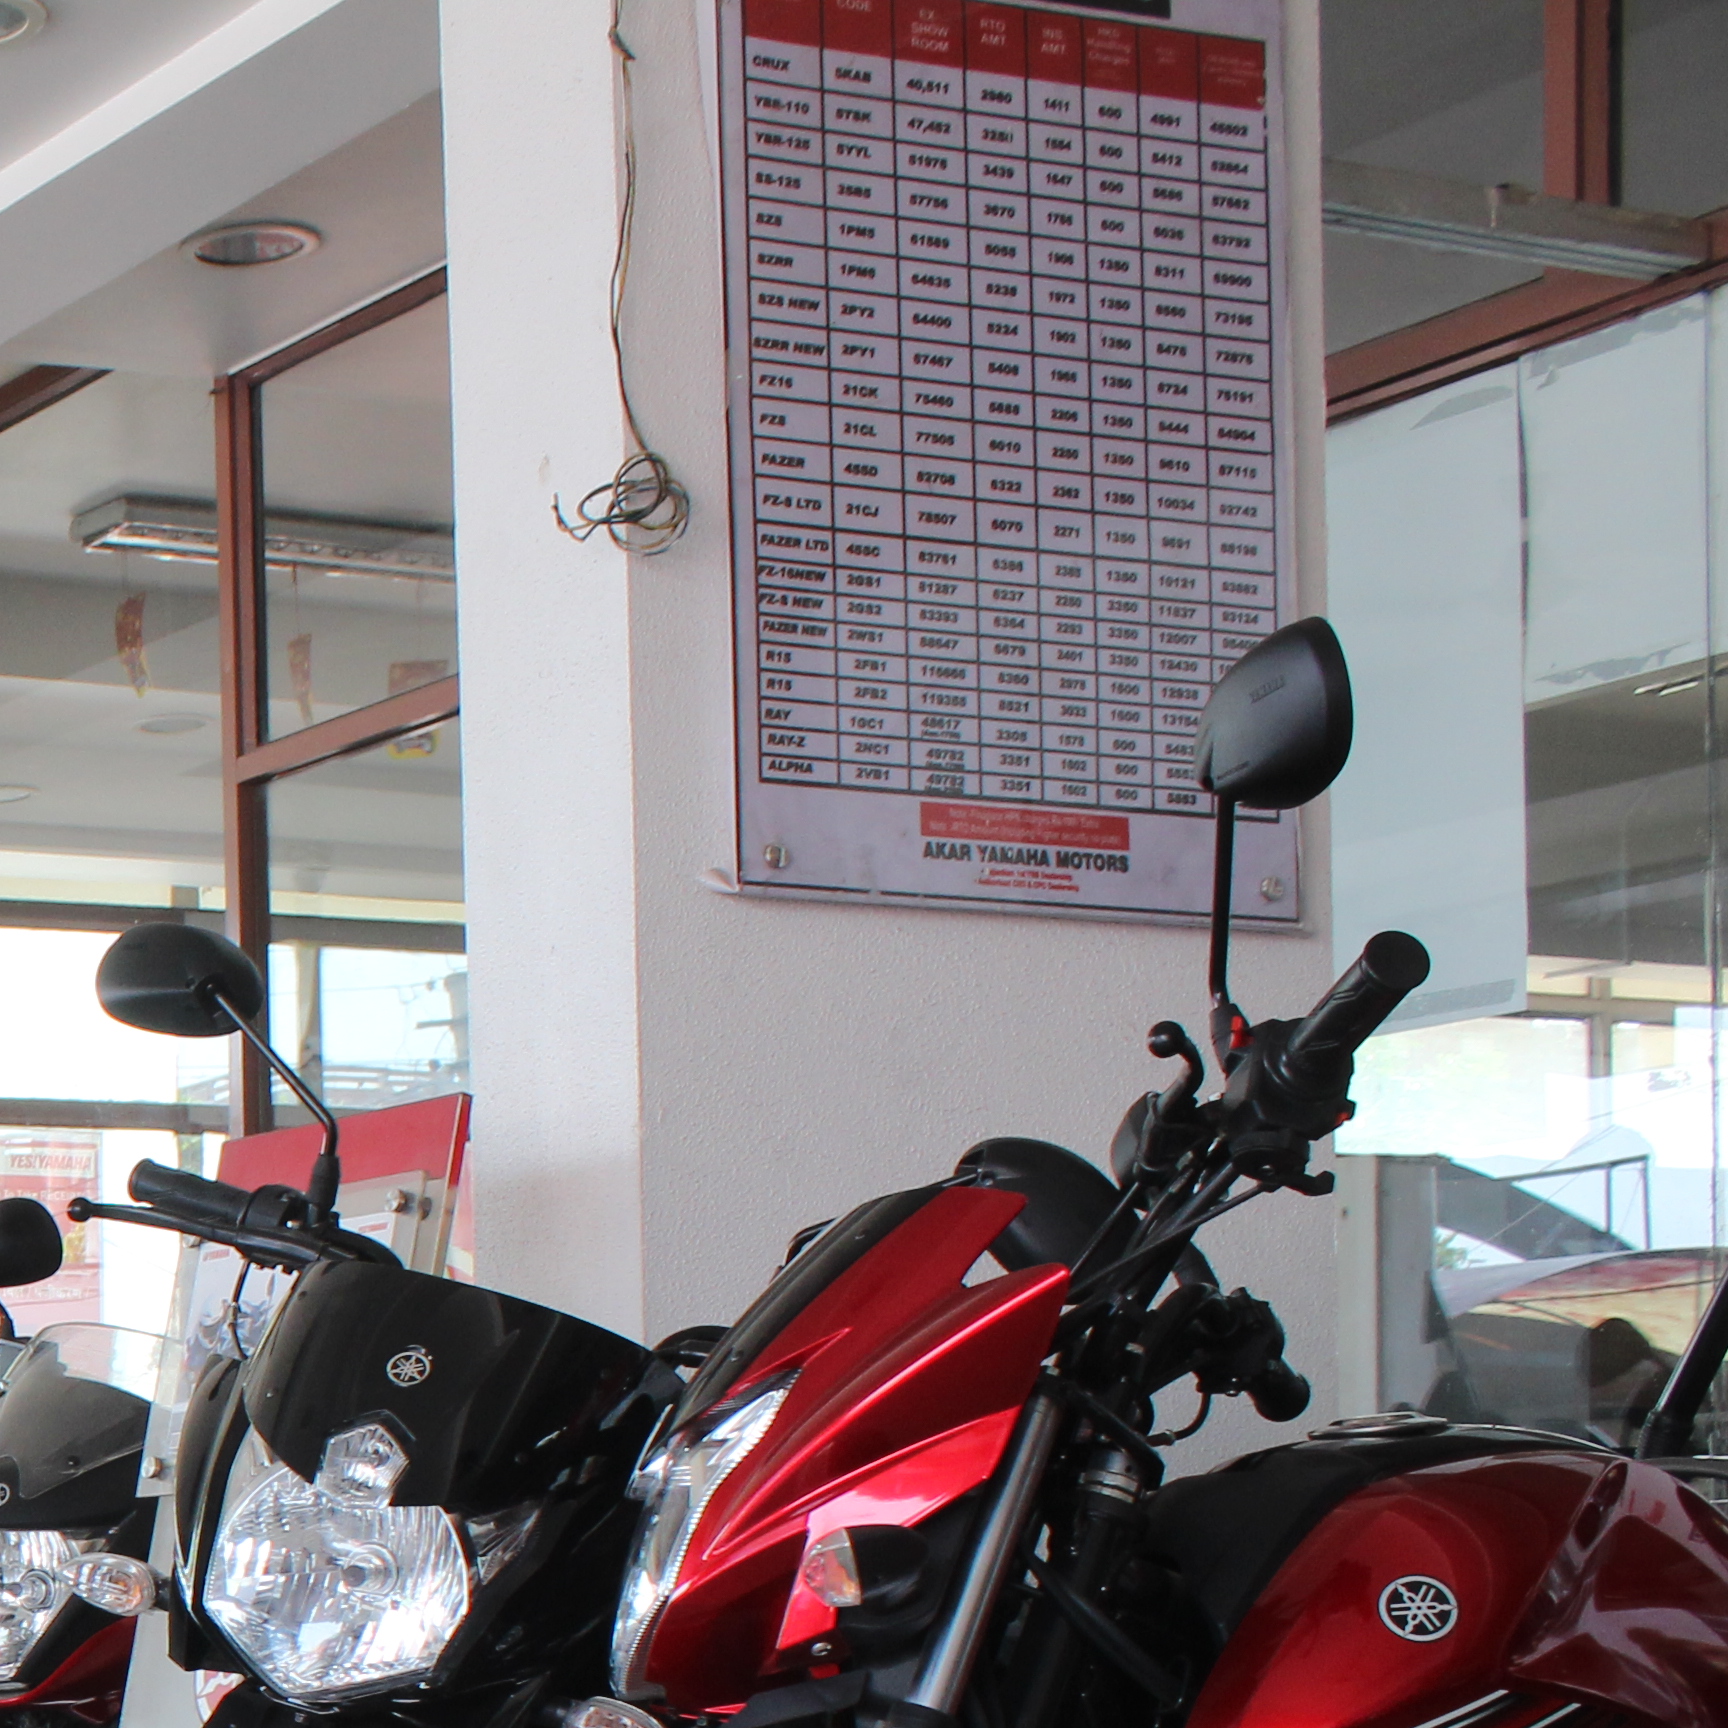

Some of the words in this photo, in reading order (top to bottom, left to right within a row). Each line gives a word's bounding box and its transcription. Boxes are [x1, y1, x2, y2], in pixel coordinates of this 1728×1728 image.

[911, 22, 949, 37] SHOW
[911, 38, 949, 53] ROOM
[751, 54, 791, 71] CRUX
[1043, 97, 1070, 112] 1411
[1097, 105, 1122, 120] 600
[1098, 144, 1123, 159] 600
[1099, 179, 1124, 194] 600
[1100, 218, 1125, 233] 600
[788, 296, 820, 312] NEW
[840, 303, 875, 319] 2PY2
[986, 322, 1019, 337] 5224
[792, 341, 826, 357] NEW
[841, 343, 876, 359] 2PY1
[758, 374, 793, 389] FZ16
[842, 383, 879, 399] 21CK
[843, 421, 877, 438] 21CL
[988, 439, 1022, 454] 6010
[760, 452, 806, 469] FAZER
[796, 495, 822, 511] LTD
[845, 502, 880, 518] 21CJ
[1053, 524, 1080, 539] 2271
[760, 533, 801, 549] FAZER
[805, 537, 830, 553] LTD
[792, 594, 824, 610] NEW
[762, 620, 799, 636] FAZER
[800, 622, 828, 639] NEW
[764, 707, 792, 721] RAY
[767, 733, 806, 748] RAY-Z
[768, 759, 813, 773] ALPHA
[923, 840, 972, 861] AKAR
[976, 844, 1050, 868] YAMAHA
[1055, 850, 1129, 873] MOTORS
